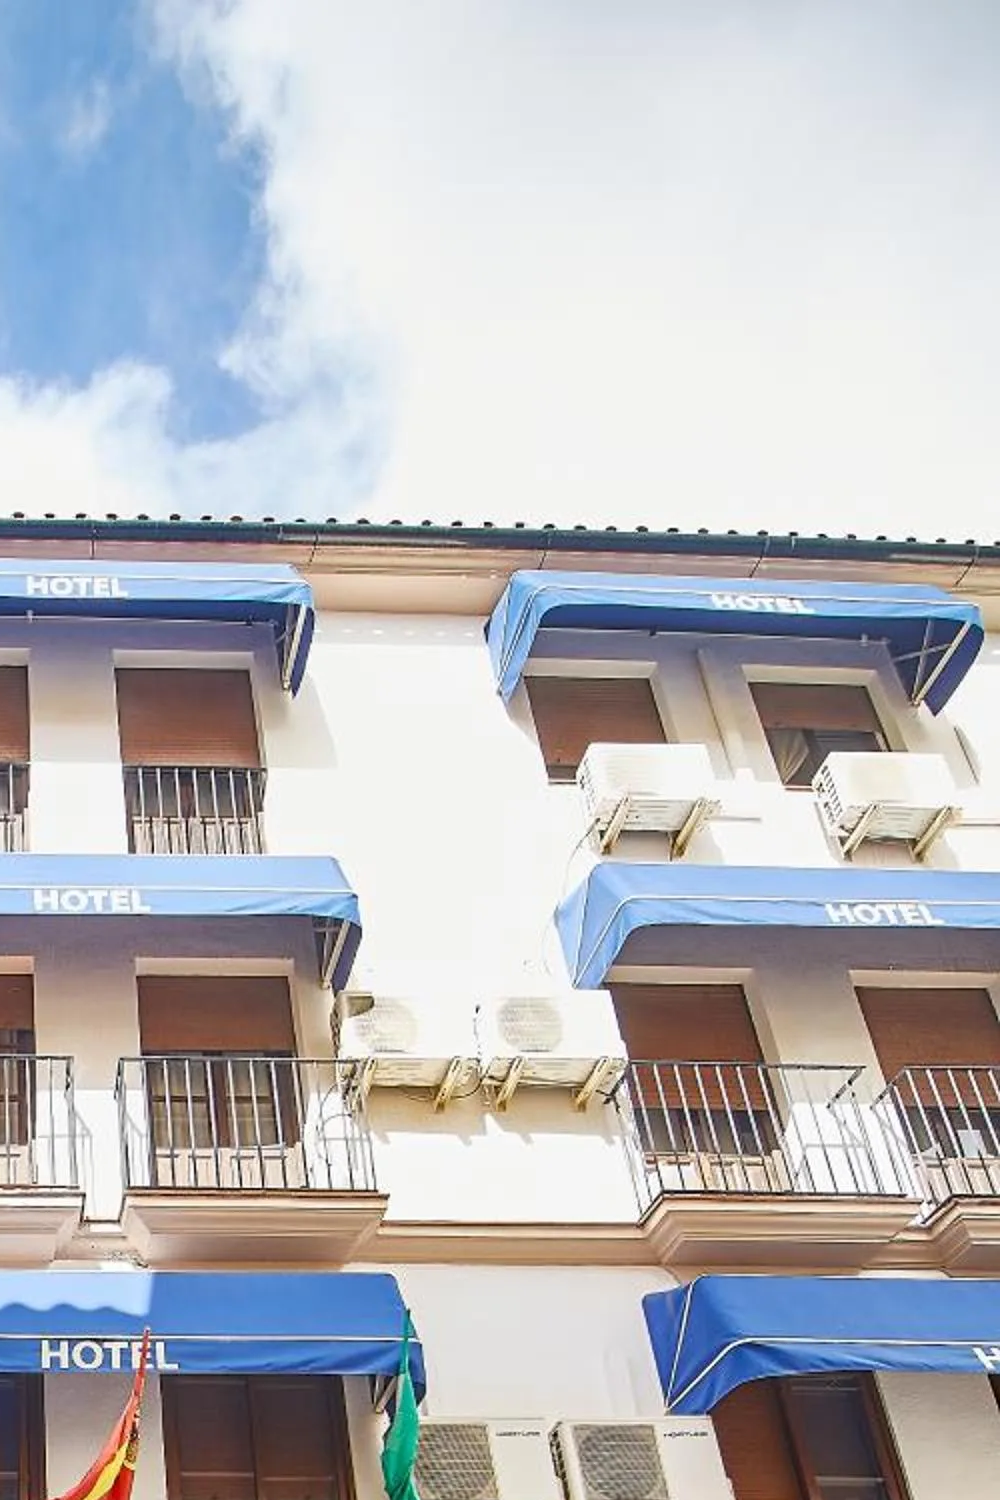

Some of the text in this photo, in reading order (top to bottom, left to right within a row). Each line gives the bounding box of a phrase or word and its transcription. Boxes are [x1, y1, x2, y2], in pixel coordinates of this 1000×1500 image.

[26, 576, 130, 598] HOTEL
[711, 593, 816, 615] HOTEL
[33, 889, 151, 913] HOTEL
[824, 903, 945, 926] HOTEL
[41, 1339, 179, 1370] HOTEL
